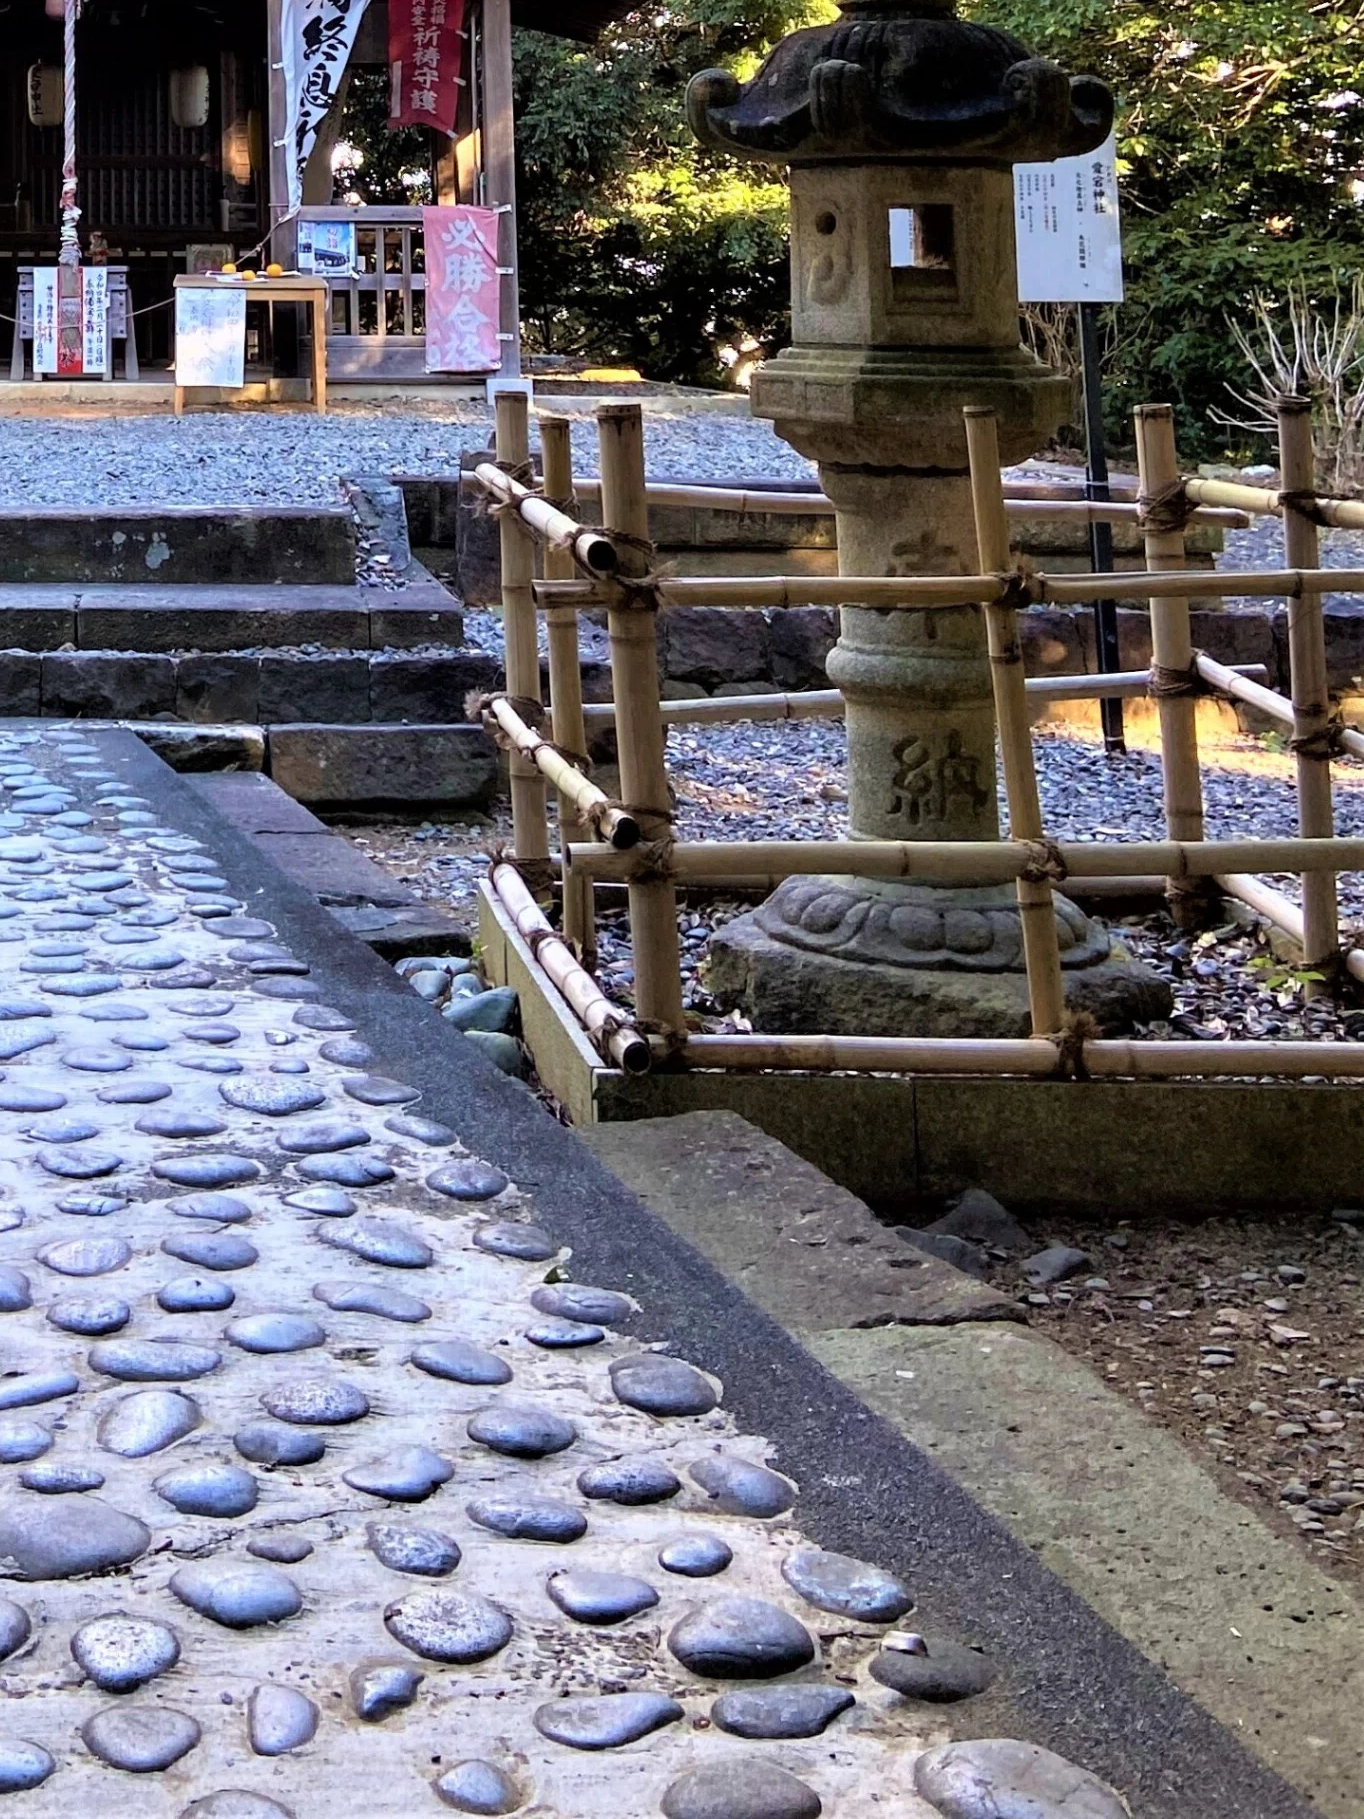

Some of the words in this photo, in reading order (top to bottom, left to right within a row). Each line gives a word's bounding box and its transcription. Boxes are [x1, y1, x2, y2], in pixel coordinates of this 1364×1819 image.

[1091, 161, 1106, 215] 愛宕神社
[440, 218, 493, 370] 必勝合格
